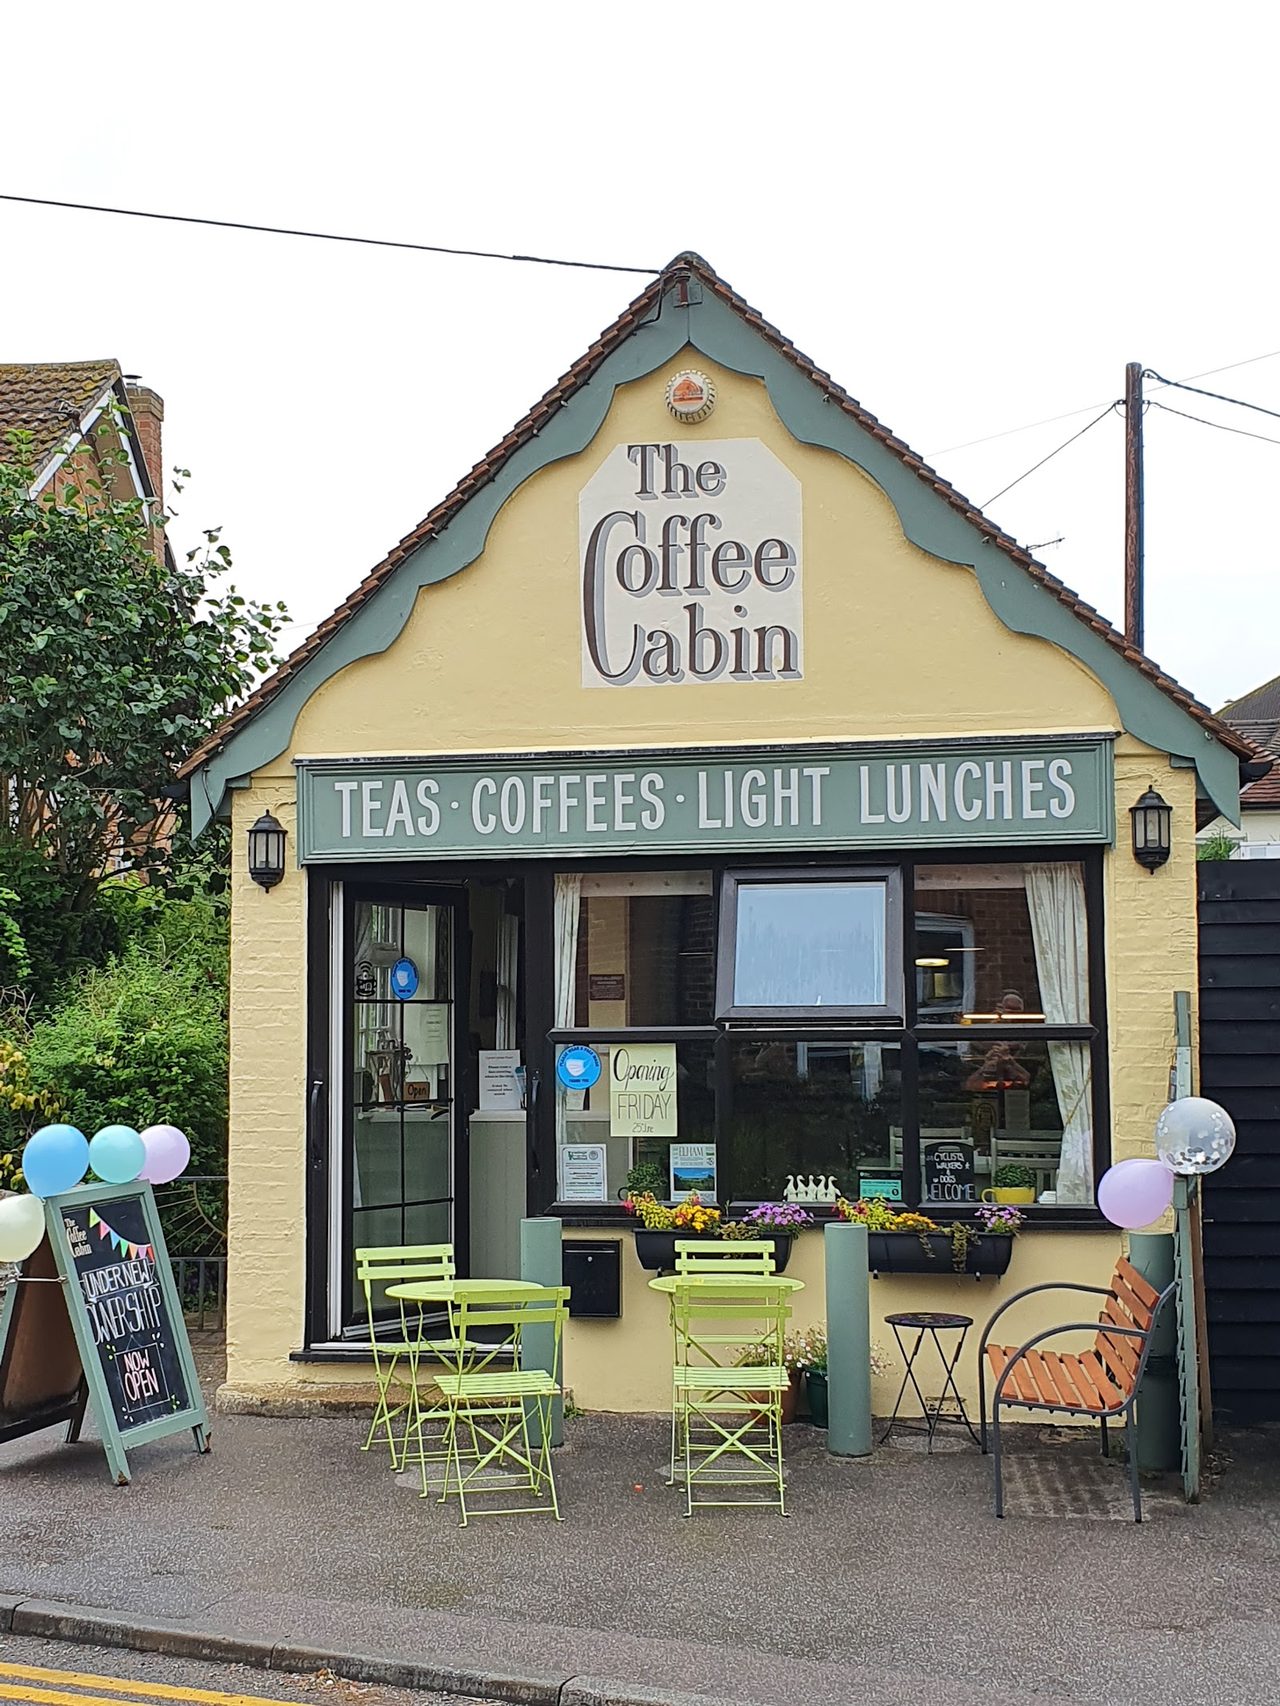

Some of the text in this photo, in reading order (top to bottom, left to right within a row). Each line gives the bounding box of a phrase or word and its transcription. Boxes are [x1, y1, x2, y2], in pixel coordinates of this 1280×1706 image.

[627, 444, 726, 500] The
[583, 510, 797, 598] Coffee
[583, 602, 803, 686] Cabin
[334, 758, 1075, 839] TEAS COFFEES LIGHT LUNCHES
[617, 1093, 671, 1120] FRIDAY
[939, 1175, 957, 1183] DOGS
[85, 1259, 150, 1298] UNDER NEW
[123, 1348, 150, 1373] NOW
[124, 1367, 160, 1401] OPEN
